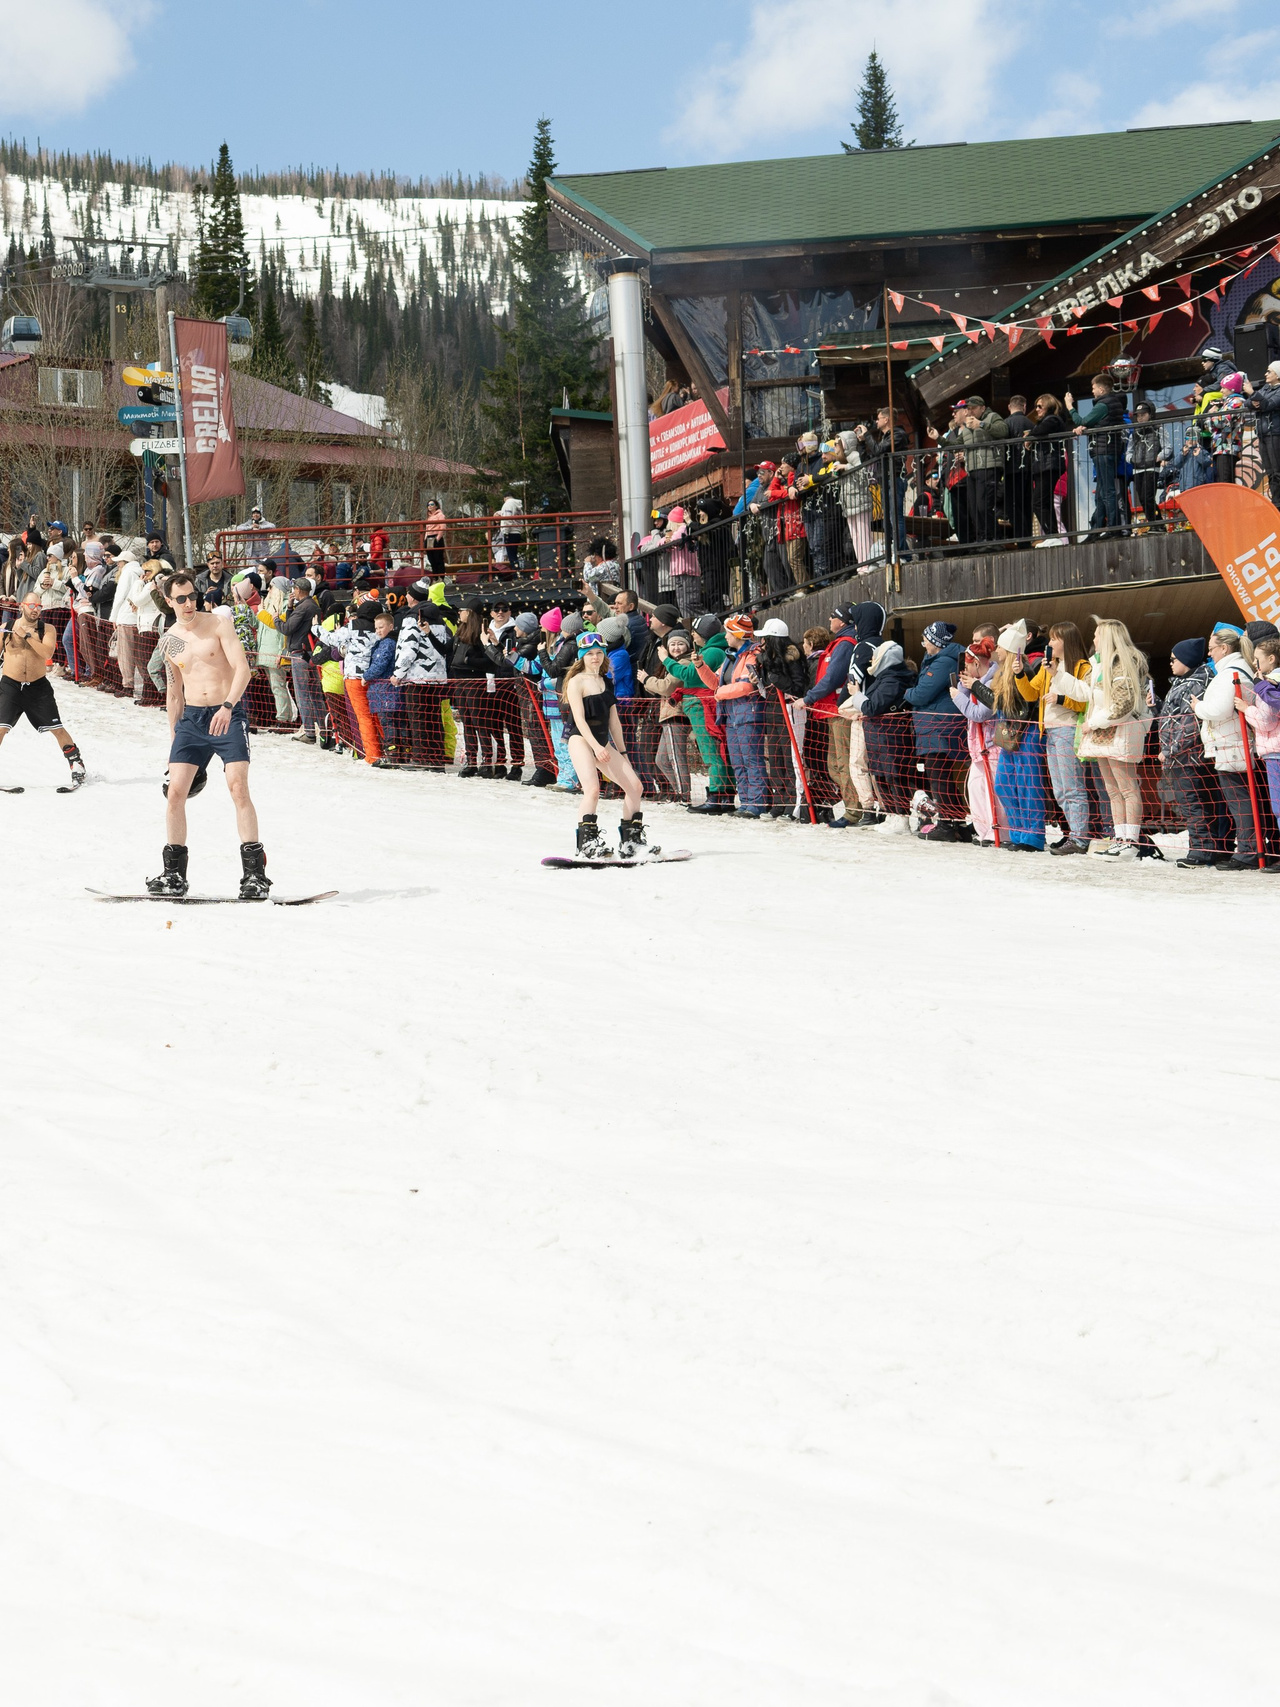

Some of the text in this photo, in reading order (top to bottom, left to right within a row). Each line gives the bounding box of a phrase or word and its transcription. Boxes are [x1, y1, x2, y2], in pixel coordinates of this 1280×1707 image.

[1197, 186, 1263, 236] ЭТО
[115, 304, 127, 314] 13
[191, 365, 219, 453] GRELKA
[123, 411, 159, 420] Mammoth
[141, 440, 181, 450] ELIZABE
